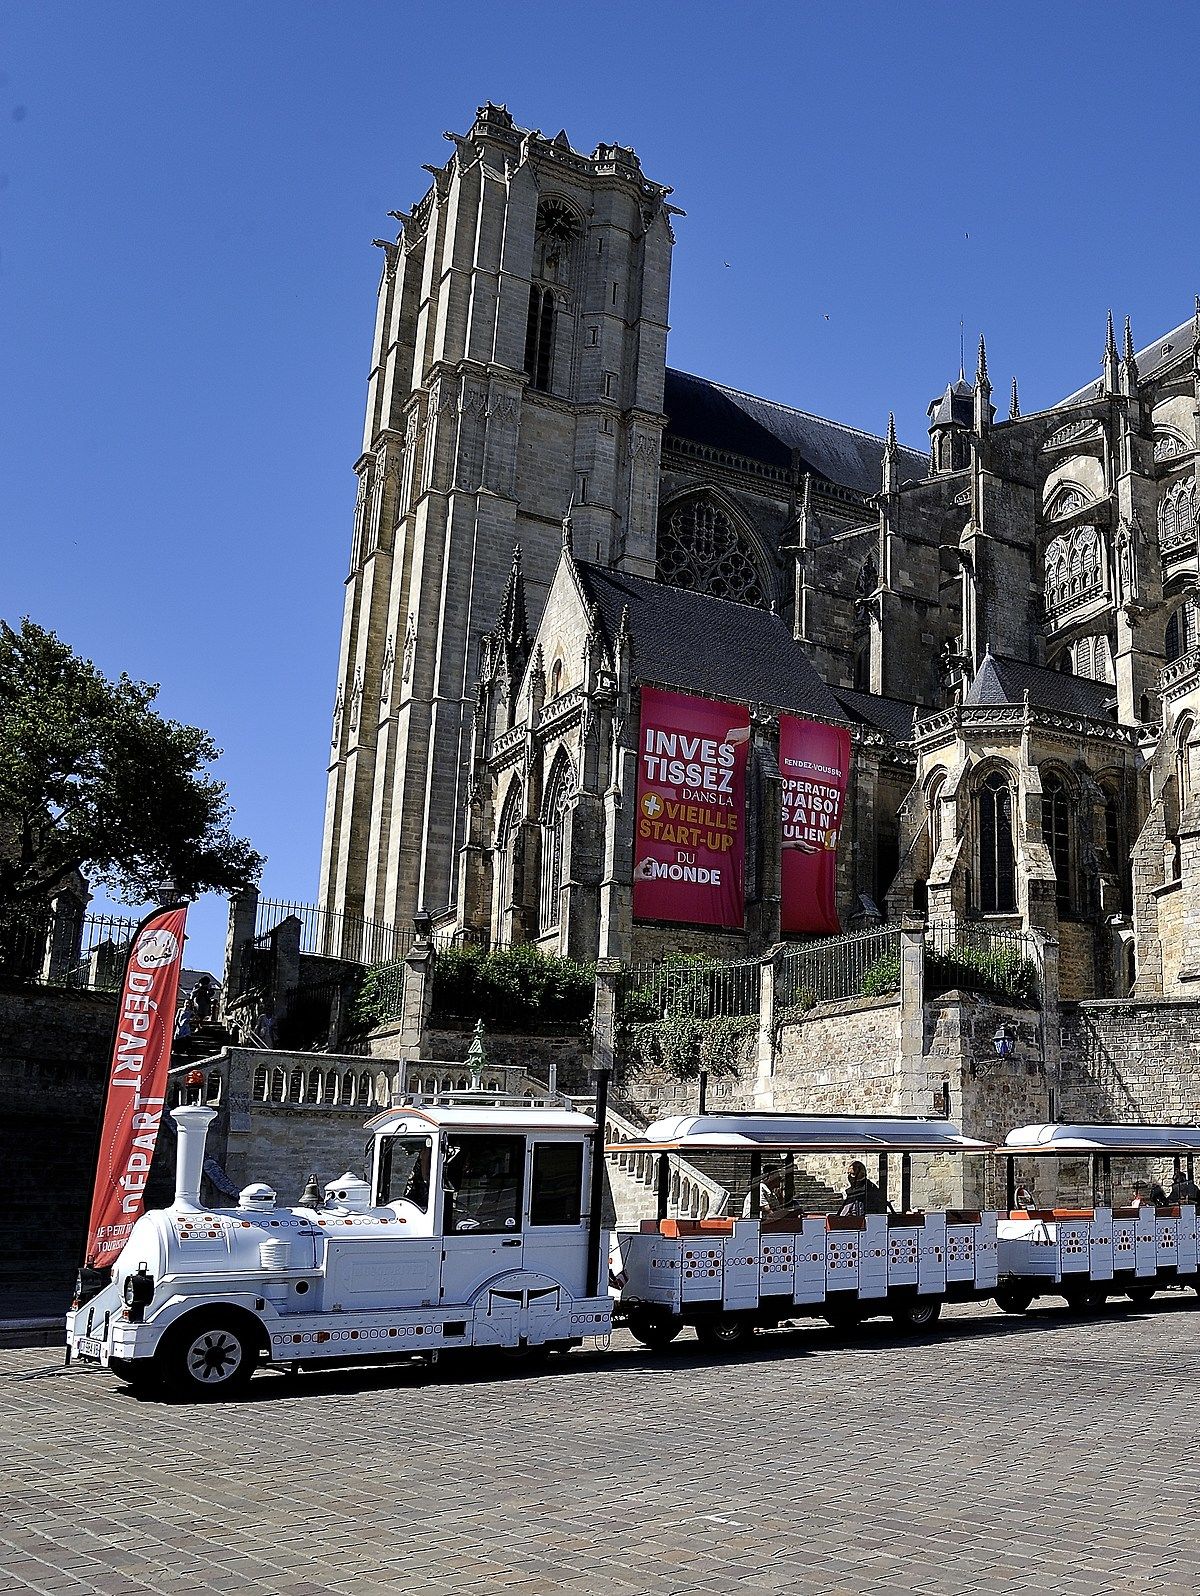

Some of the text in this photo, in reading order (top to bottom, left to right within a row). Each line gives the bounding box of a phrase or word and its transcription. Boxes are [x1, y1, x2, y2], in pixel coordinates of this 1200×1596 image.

[646, 728, 736, 767] INVES
[643, 755, 735, 793] TISSEZ
[682, 788, 734, 807] DANS LA
[666, 801, 738, 830] VIEILLE
[782, 807, 837, 829] SAIN
[639, 819, 734, 852] START-UP
[783, 824, 826, 843] ULIEN
[677, 851, 695, 865] DU
[652, 861, 721, 886] MONDE
[112, 971, 158, 1091] DÉPART
